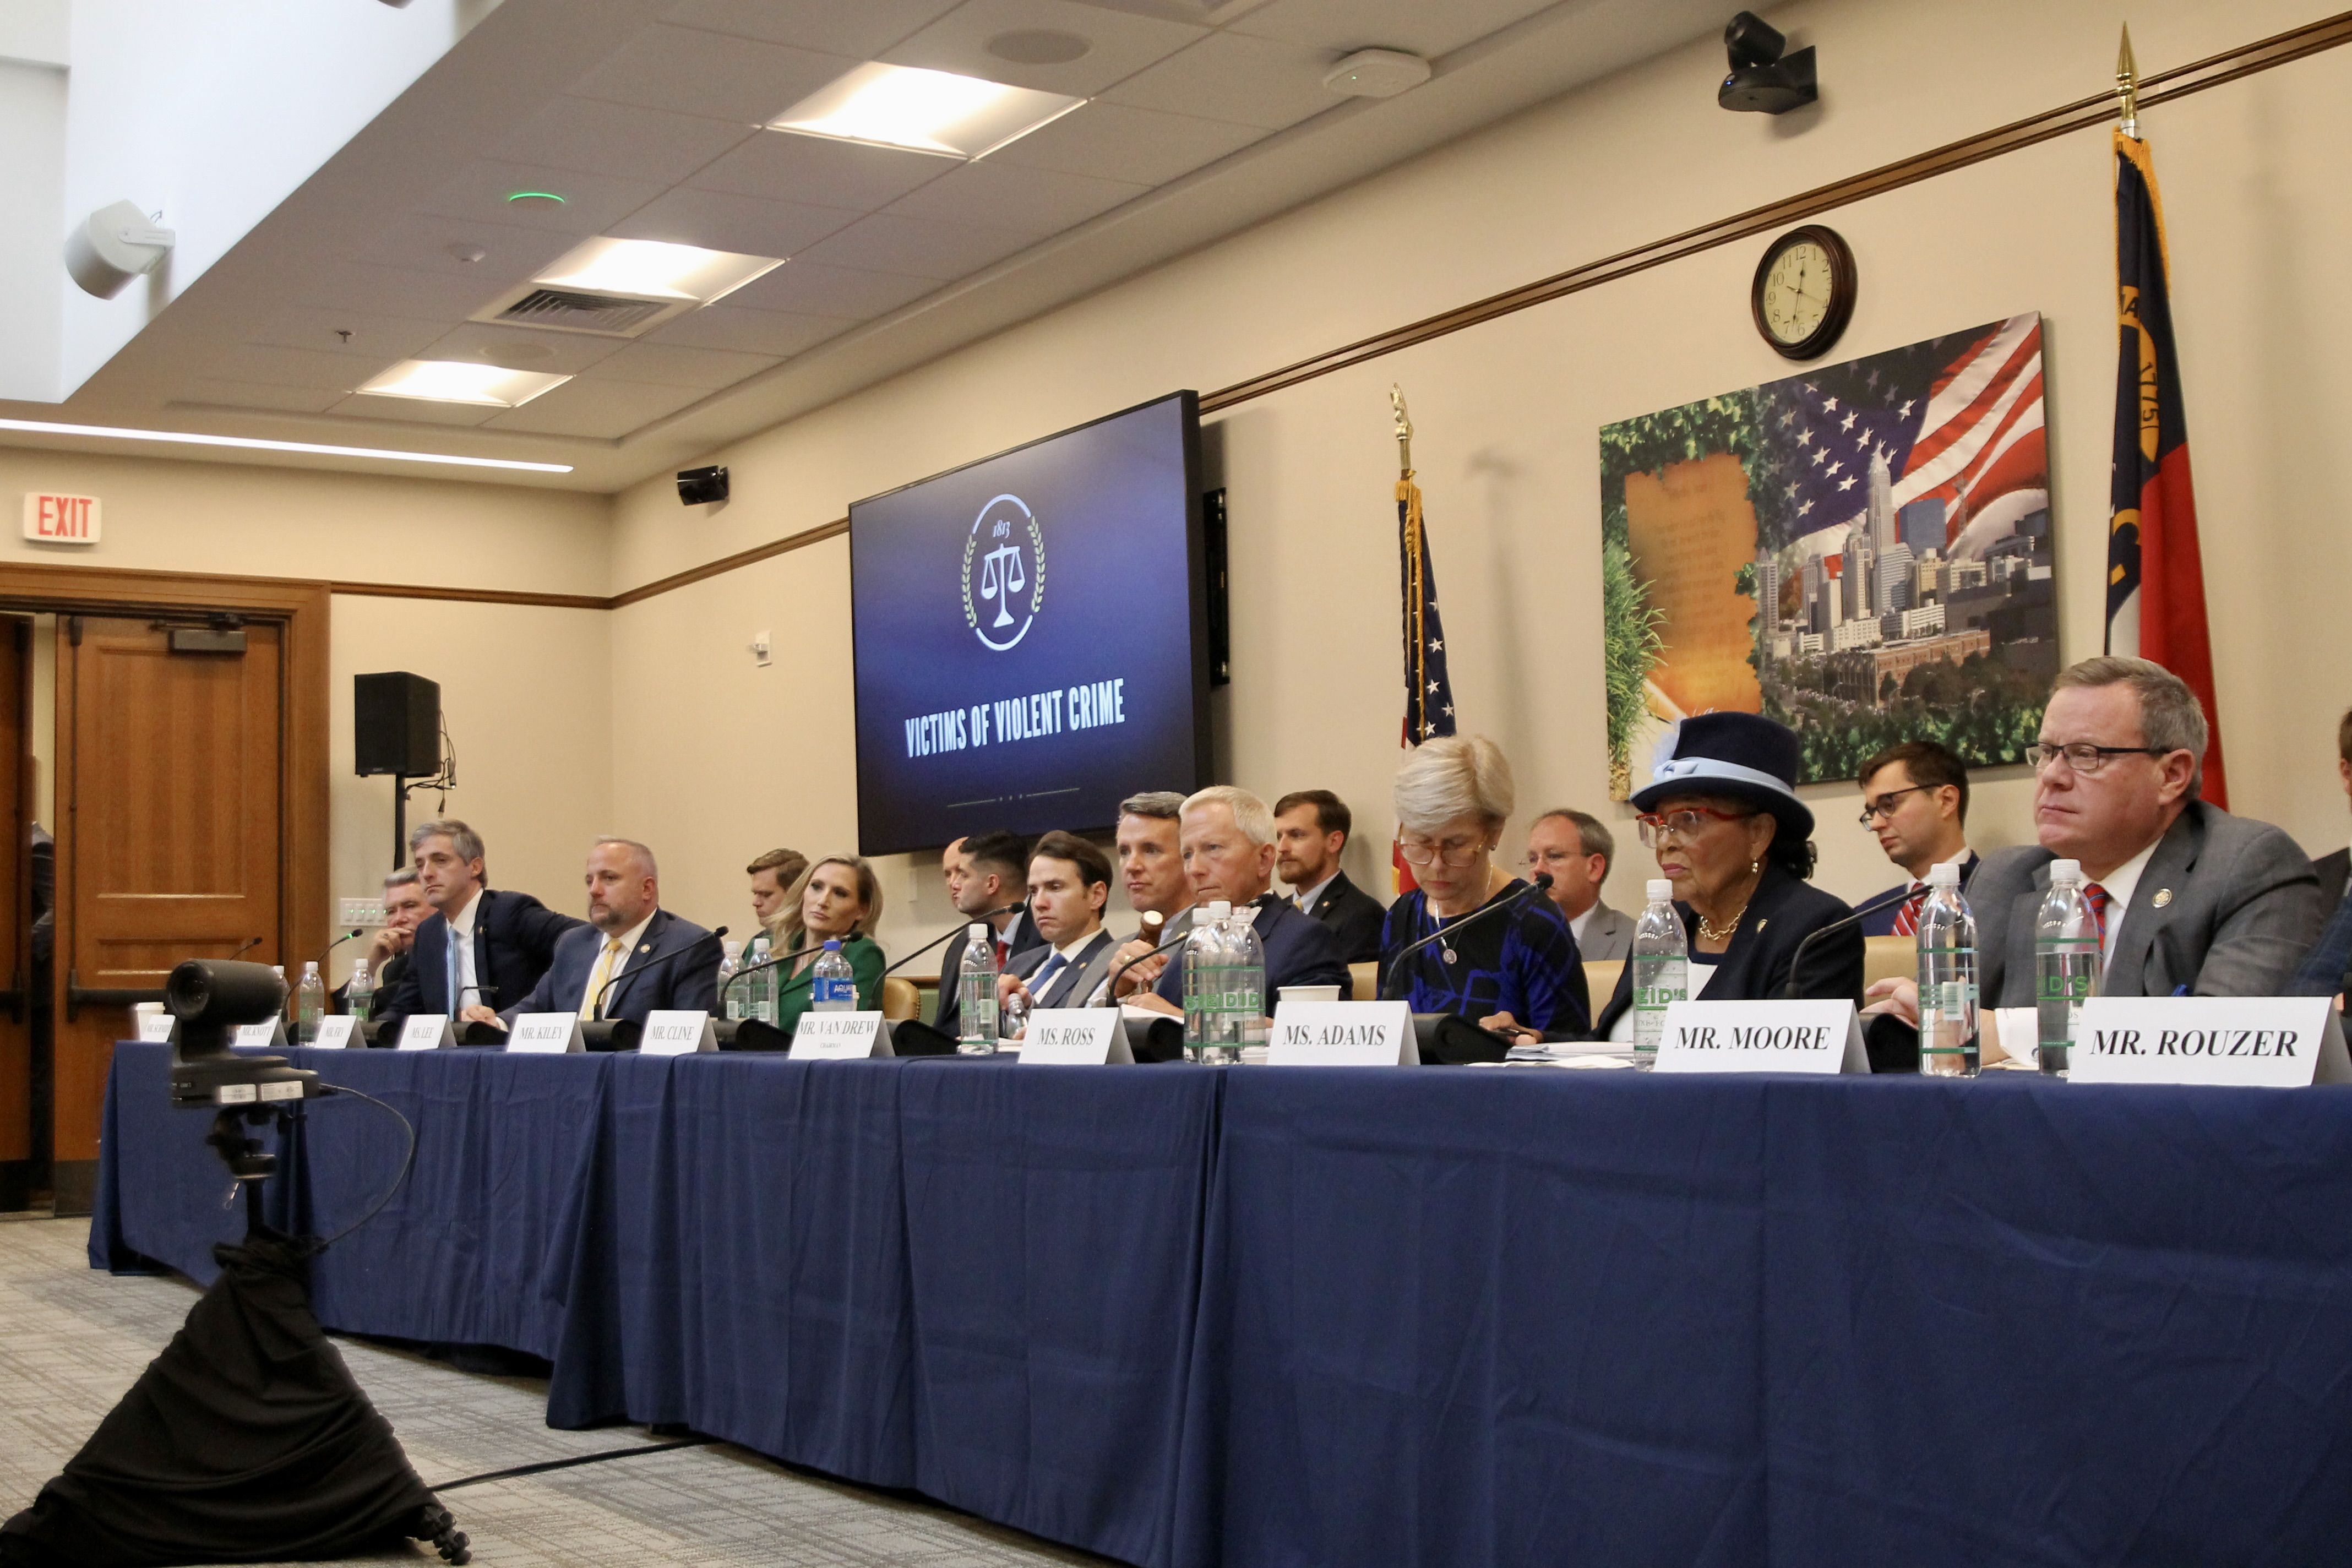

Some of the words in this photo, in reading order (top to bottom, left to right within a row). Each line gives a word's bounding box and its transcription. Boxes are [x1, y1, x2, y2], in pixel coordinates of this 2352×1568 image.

[1795, 246, 1806, 260] 12
[1811, 247, 1817, 260] 1
[1782, 254, 1792, 269] 11
[1822, 259, 1831, 273] 2
[1772, 272, 1784, 287] 10
[1768, 291, 1777, 304] 9
[1773, 309, 1781, 323] 8
[1811, 313, 1820, 329] 5
[1783, 320, 1790, 334] 7
[1797, 323, 1806, 336] 6
[39, 496, 92, 538] EXIT
[993, 519, 1010, 538] 1813
[905, 708, 967, 758] VICTIMS
[970, 703, 990, 747] OF
[994, 689, 1063, 743] VIOLENT
[1068, 678, 1125, 731] CRIME
[421, 1027, 434, 1038] LEE
[519, 1027, 535, 1039] MR.
[537, 1026, 565, 1039] KILEY
[651, 1026, 665, 1039] MR.
[667, 1026, 694, 1040] CLINE
[798, 1021, 815, 1035] MR.
[820, 1021, 842, 1035] VAN
[843, 1021, 877, 1035] DREW
[1037, 1027, 1058, 1045] MS.
[1061, 1027, 1096, 1046] ROSS
[1283, 1025, 1313, 1045] MS.
[1317, 1025, 1386, 1046] ADAMS
[1674, 1026, 1720, 1049] MR.
[1729, 1026, 1831, 1050] MOORE
[2089, 1030, 2147, 1055] MR.
[2157, 1030, 2299, 1057] ROUZER
